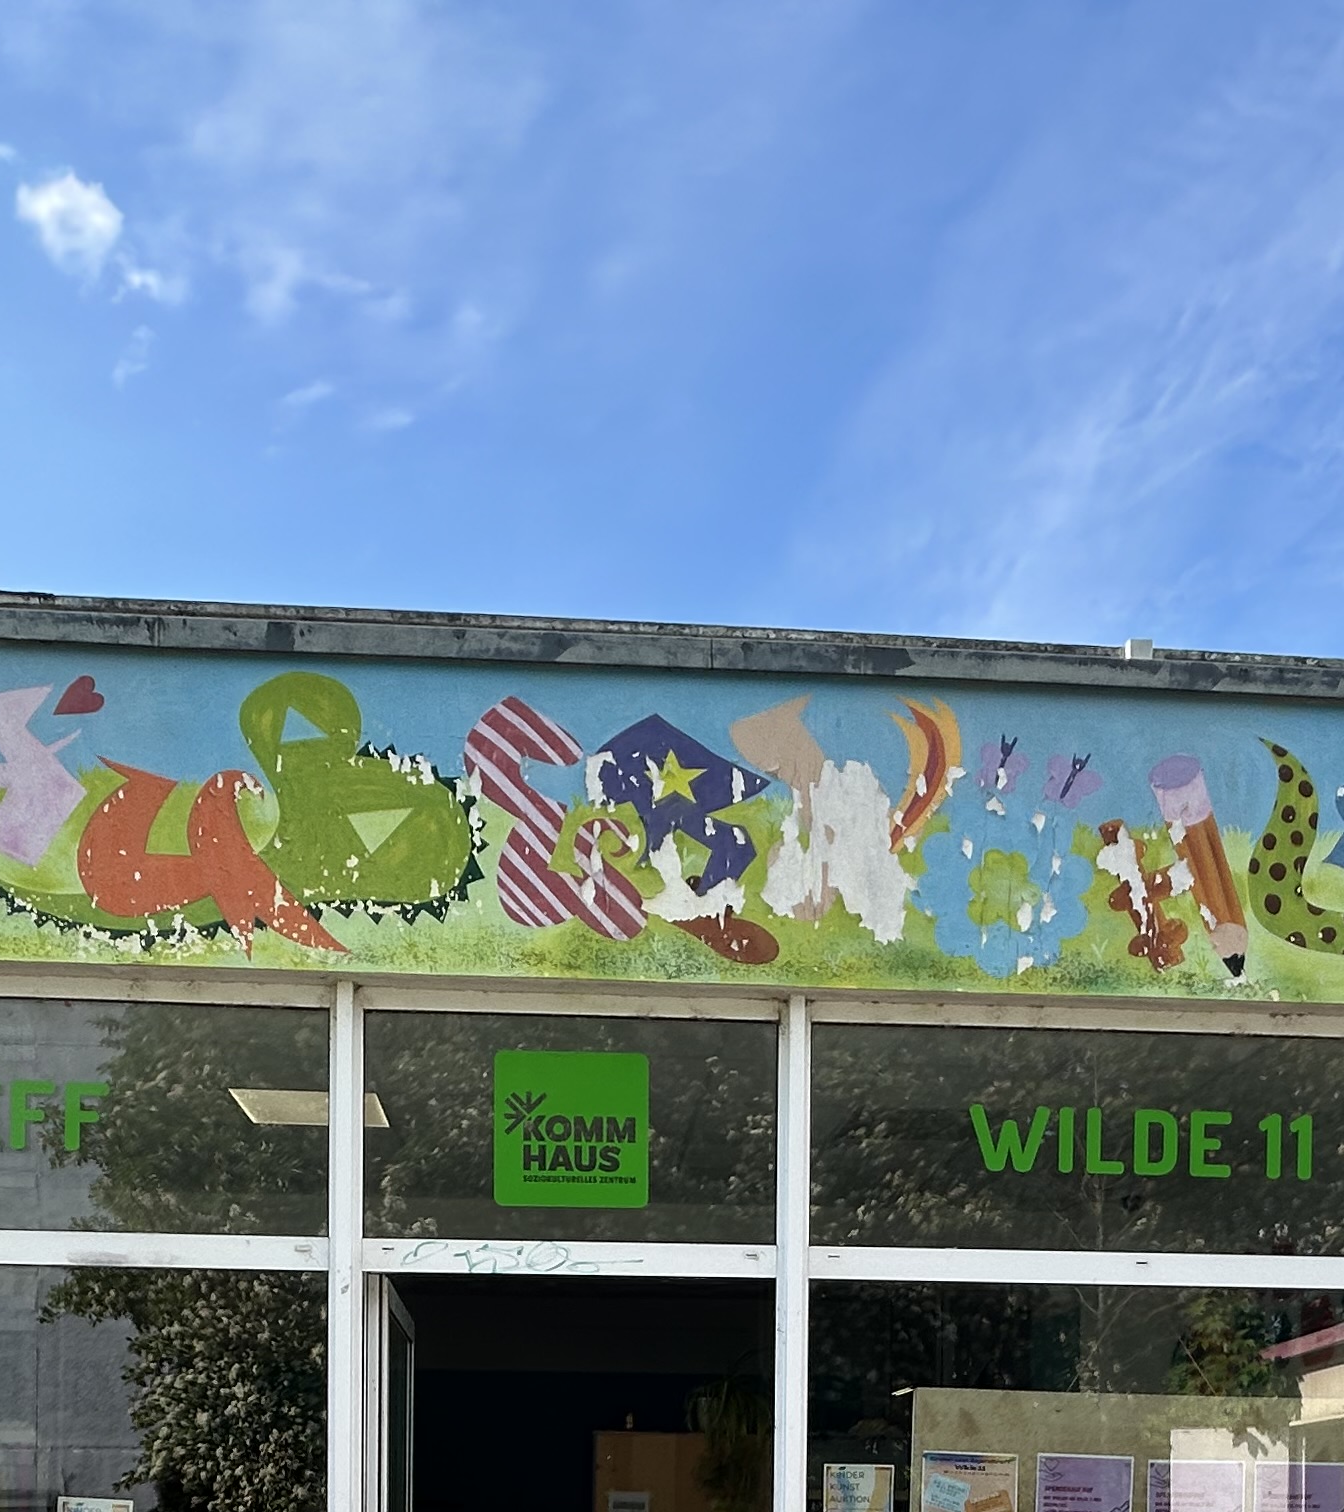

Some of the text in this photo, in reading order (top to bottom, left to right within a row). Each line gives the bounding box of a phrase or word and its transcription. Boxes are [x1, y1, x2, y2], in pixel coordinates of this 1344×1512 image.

[523, 1115, 636, 1143] KOMM
[970, 1104, 1313, 1180] WILDE 11
[523, 1144, 621, 1172] HAUS
[599, 1176, 637, 1184] ZENTRUM
